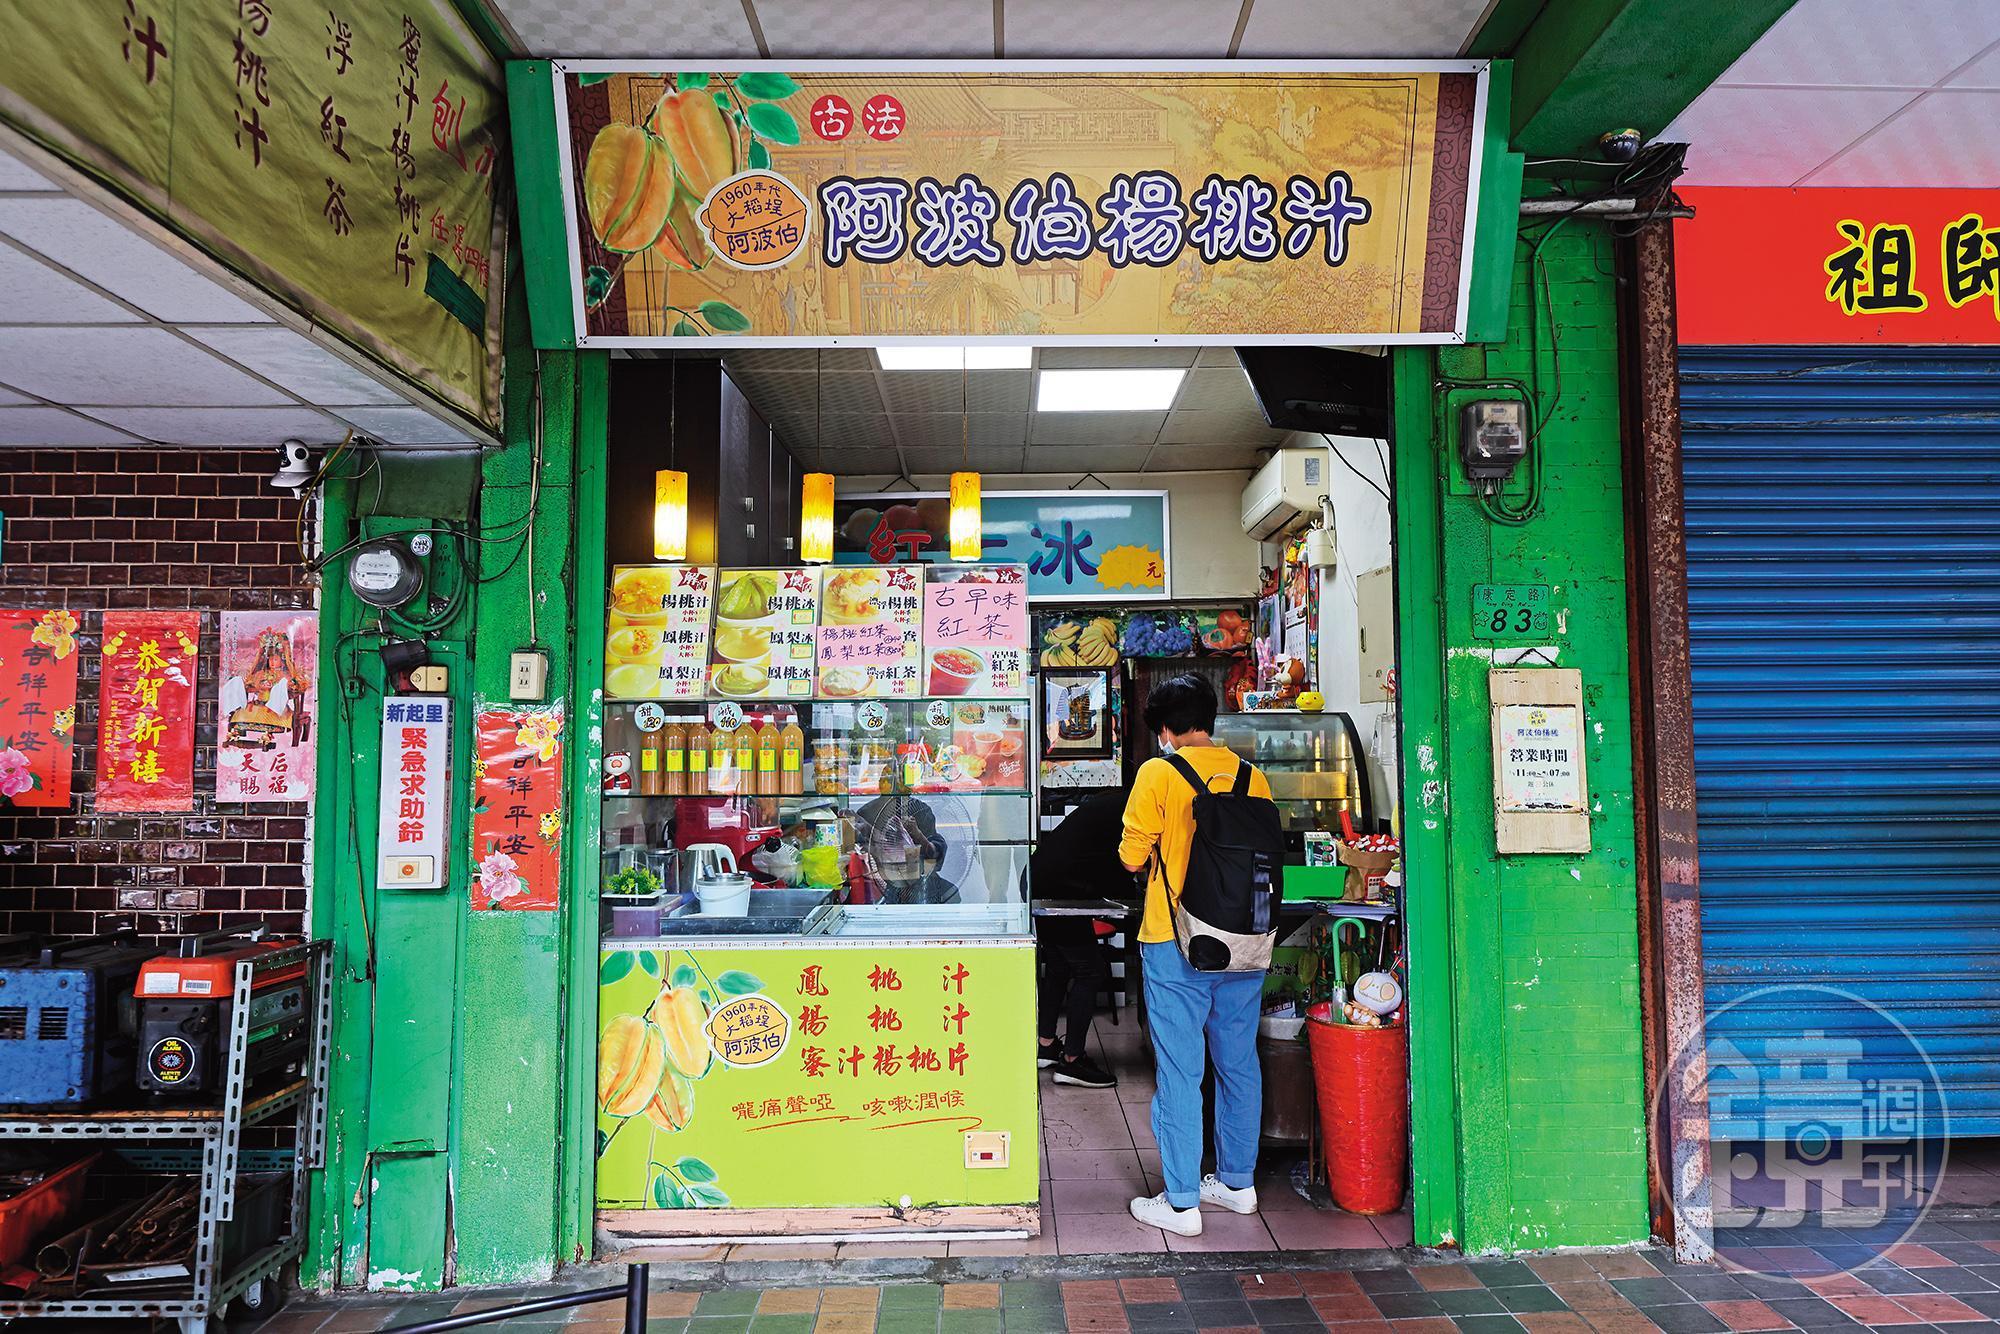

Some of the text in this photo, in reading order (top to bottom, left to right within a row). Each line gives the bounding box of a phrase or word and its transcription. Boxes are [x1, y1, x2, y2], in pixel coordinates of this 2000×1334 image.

[813, 101, 903, 138] 古法
[718, 181, 782, 210] 1960年代
[727, 197, 784, 229] 大稻埕
[817, 171, 1372, 268] 阿波伯楊桃汁
[726, 222, 799, 257] 阿波伯
[1145, 561, 1162, 579] 元
[661, 594, 709, 609] 楊桃汁
[767, 596, 815, 610] 楊桃冰
[935, 586, 1019, 615] 古早味
[822, 624, 888, 641] 楊桃紅茶
[937, 614, 1010, 640] 紅茶
[1490, 608, 1532, 633] 83
[661, 630, 706, 644] 鳳桃汁
[769, 631, 814, 645] 鳳梨冰
[820, 642, 884, 660] 鳳梨紅茶
[658, 666, 703, 680] 鳳梨汁
[767, 666, 812, 679] 鳳桃冰
[991, 659, 1020, 671] 紅茶
[127, 640, 171, 785] 恭賀新禧
[385, 703, 445, 724] 新起里
[239, 751, 289, 774] 天后
[1509, 748, 1569, 763] 營業時間
[239, 775, 289, 797] 賜福
[396, 726, 428, 844] 緊急求助鈴
[796, 962, 971, 997] 鳳桃汁
[721, 1002, 769, 1024] 1960年代
[797, 1002, 971, 1037] 楊桃汁
[726, 1014, 770, 1038] 大稻埕
[724, 1032, 781, 1058] 阿波伯
[799, 1042, 970, 1079] 蜜汁楊桃片
[862, 1089, 966, 1118] 咳嗽潤喉
